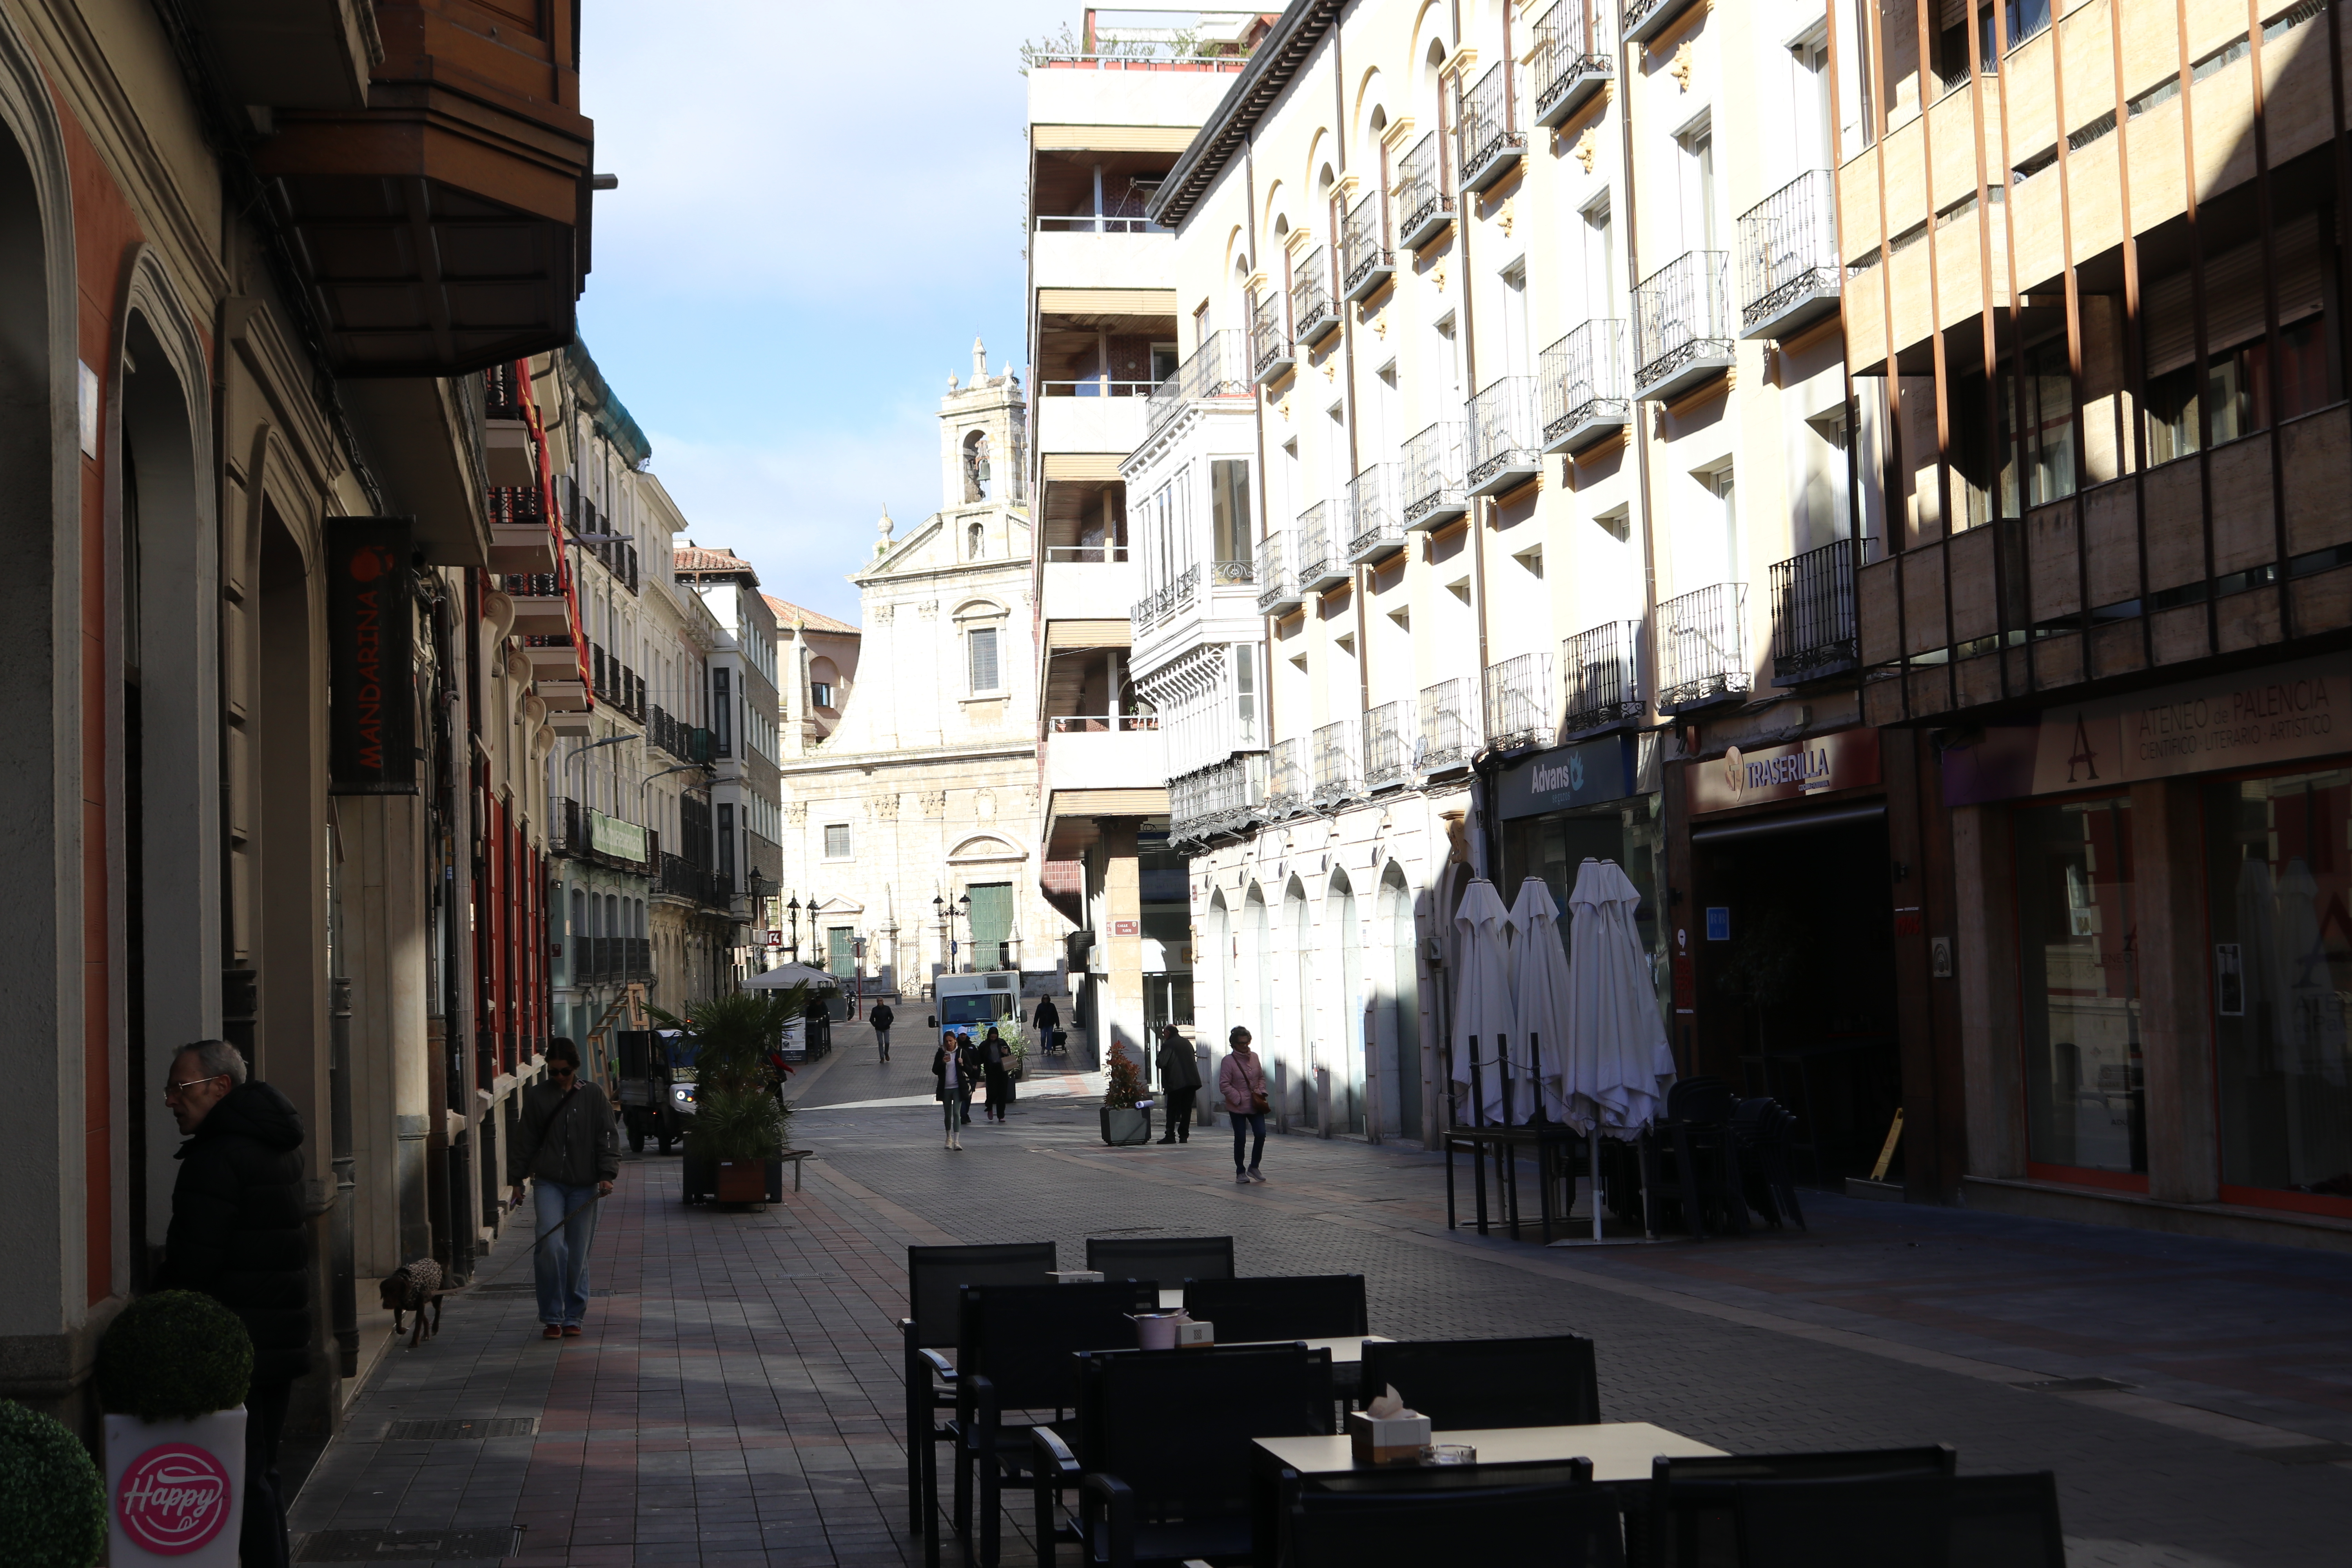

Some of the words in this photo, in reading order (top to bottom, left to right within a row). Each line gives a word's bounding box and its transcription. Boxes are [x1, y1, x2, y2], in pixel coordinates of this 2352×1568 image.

[356, 590, 382, 769] MANDARINA
[2139, 698, 2209, 737] ATENEO
[2214, 704, 2229, 725] de
[2233, 677, 2330, 721] PALENCIA
[2139, 735, 2197, 760] CIENTÍFICO
[2205, 726, 2261, 751] LITERARIO
[2269, 713, 2332, 741] ARTÍSTICO
[1531, 764, 1569, 794] Advans
[1746, 748, 1829, 789] TRASERILLA
[1552, 792, 1570, 805] seguros
[1710, 913, 1726, 924] RB
[1895, 913, 1920, 937] 1906
[1675, 958, 1691, 974] TRA
[1677, 990, 1693, 1007] LLA
[124, 1473, 220, 1518] Happy
